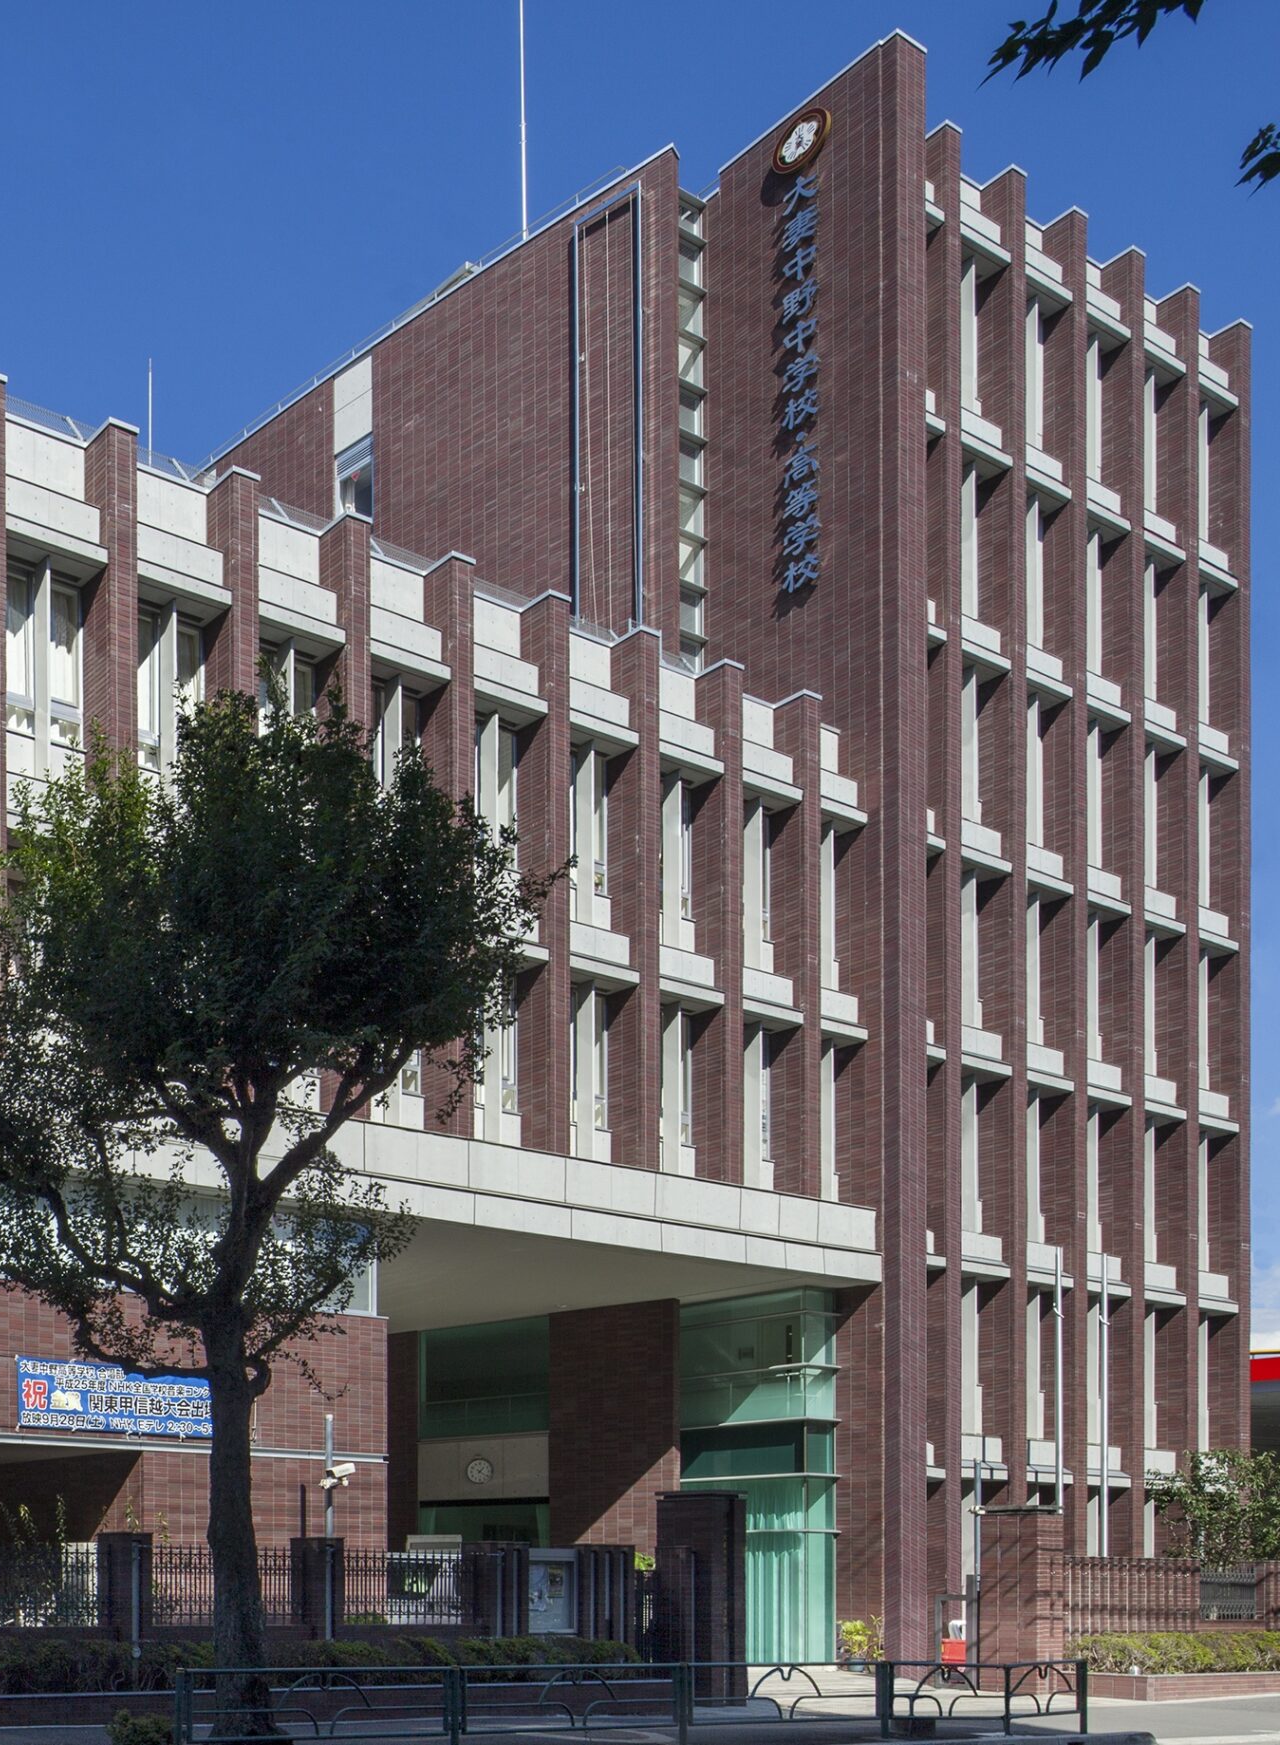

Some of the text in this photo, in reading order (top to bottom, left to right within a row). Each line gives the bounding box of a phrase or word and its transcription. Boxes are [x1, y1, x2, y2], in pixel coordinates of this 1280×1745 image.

[782, 174, 819, 594] 大妻中野中学校・高等学校
[20, 1361, 96, 1378] 大妻中野高等学校
[22, 1379, 48, 1410] 祝
[55, 1377, 106, 1392] 平成25年度
